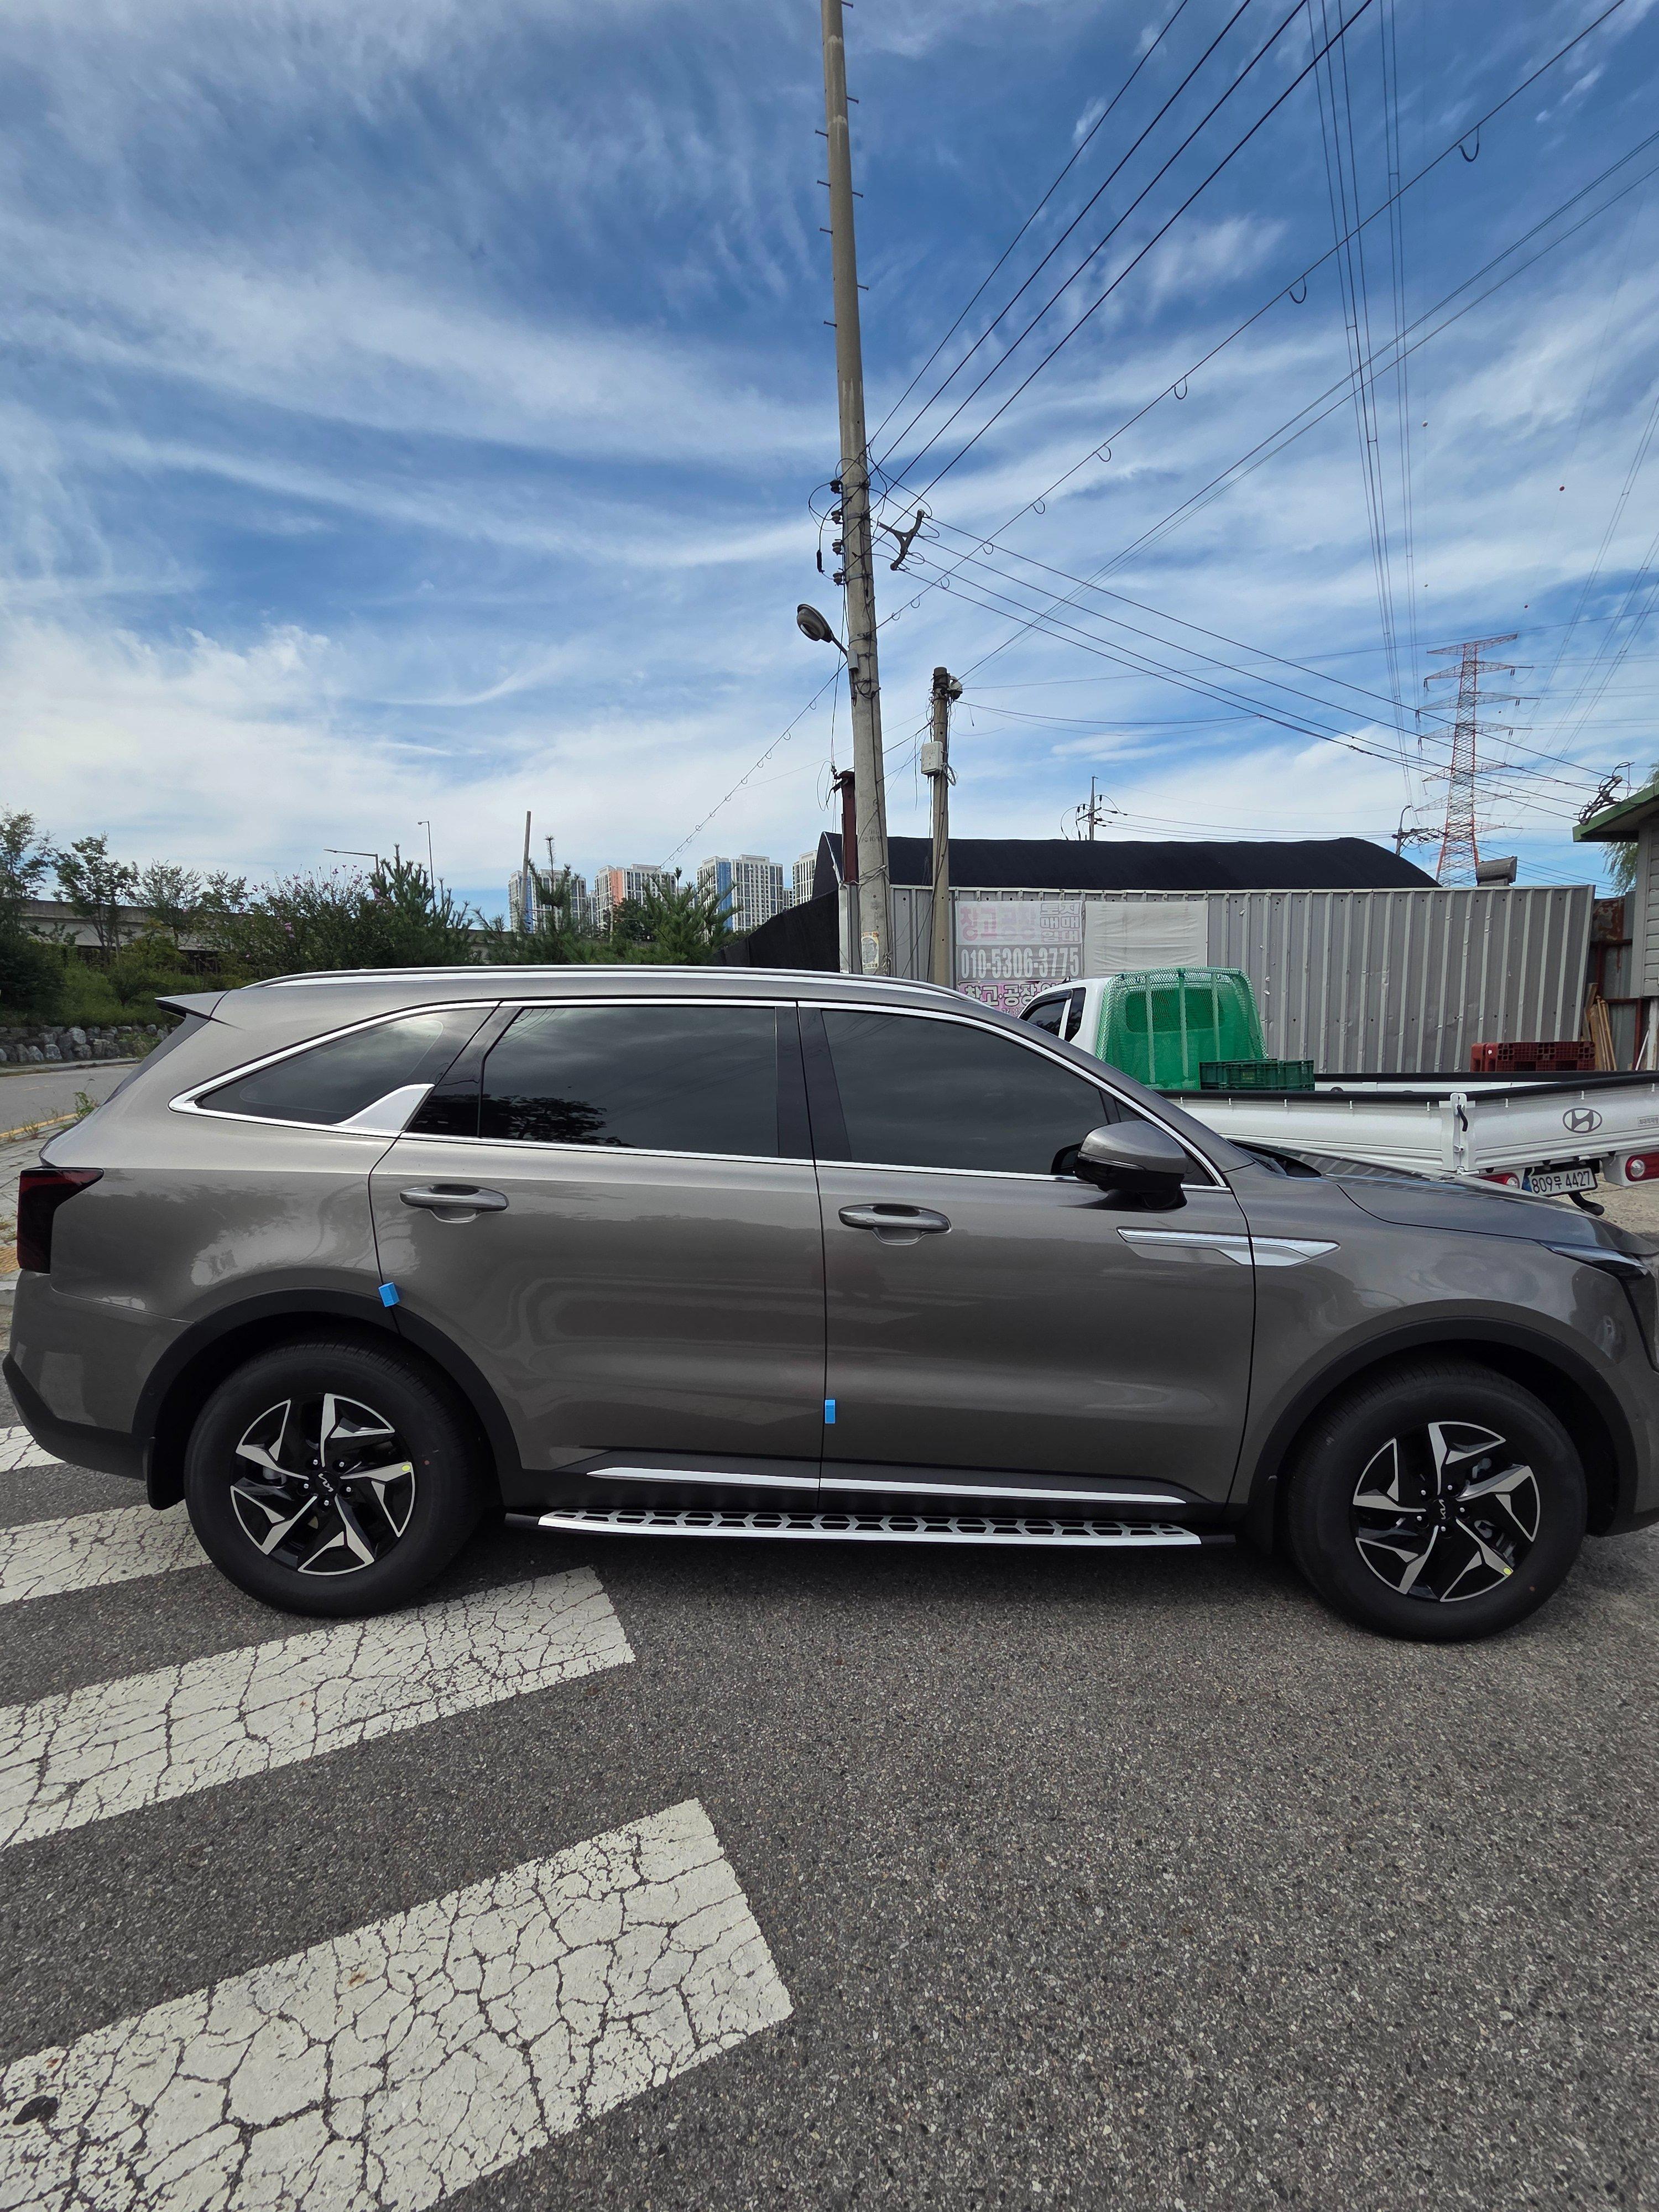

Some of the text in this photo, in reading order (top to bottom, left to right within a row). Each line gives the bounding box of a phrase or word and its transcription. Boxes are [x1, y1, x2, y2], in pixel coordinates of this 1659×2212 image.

[1040, 902, 1080, 916] 토지
[1040, 916, 1080, 929] 매매
[1041, 930, 1079, 942] 임대
[961, 947, 1079, 979] 010-5306-3775
[1532, 1170, 1590, 1194] 809무 4427
